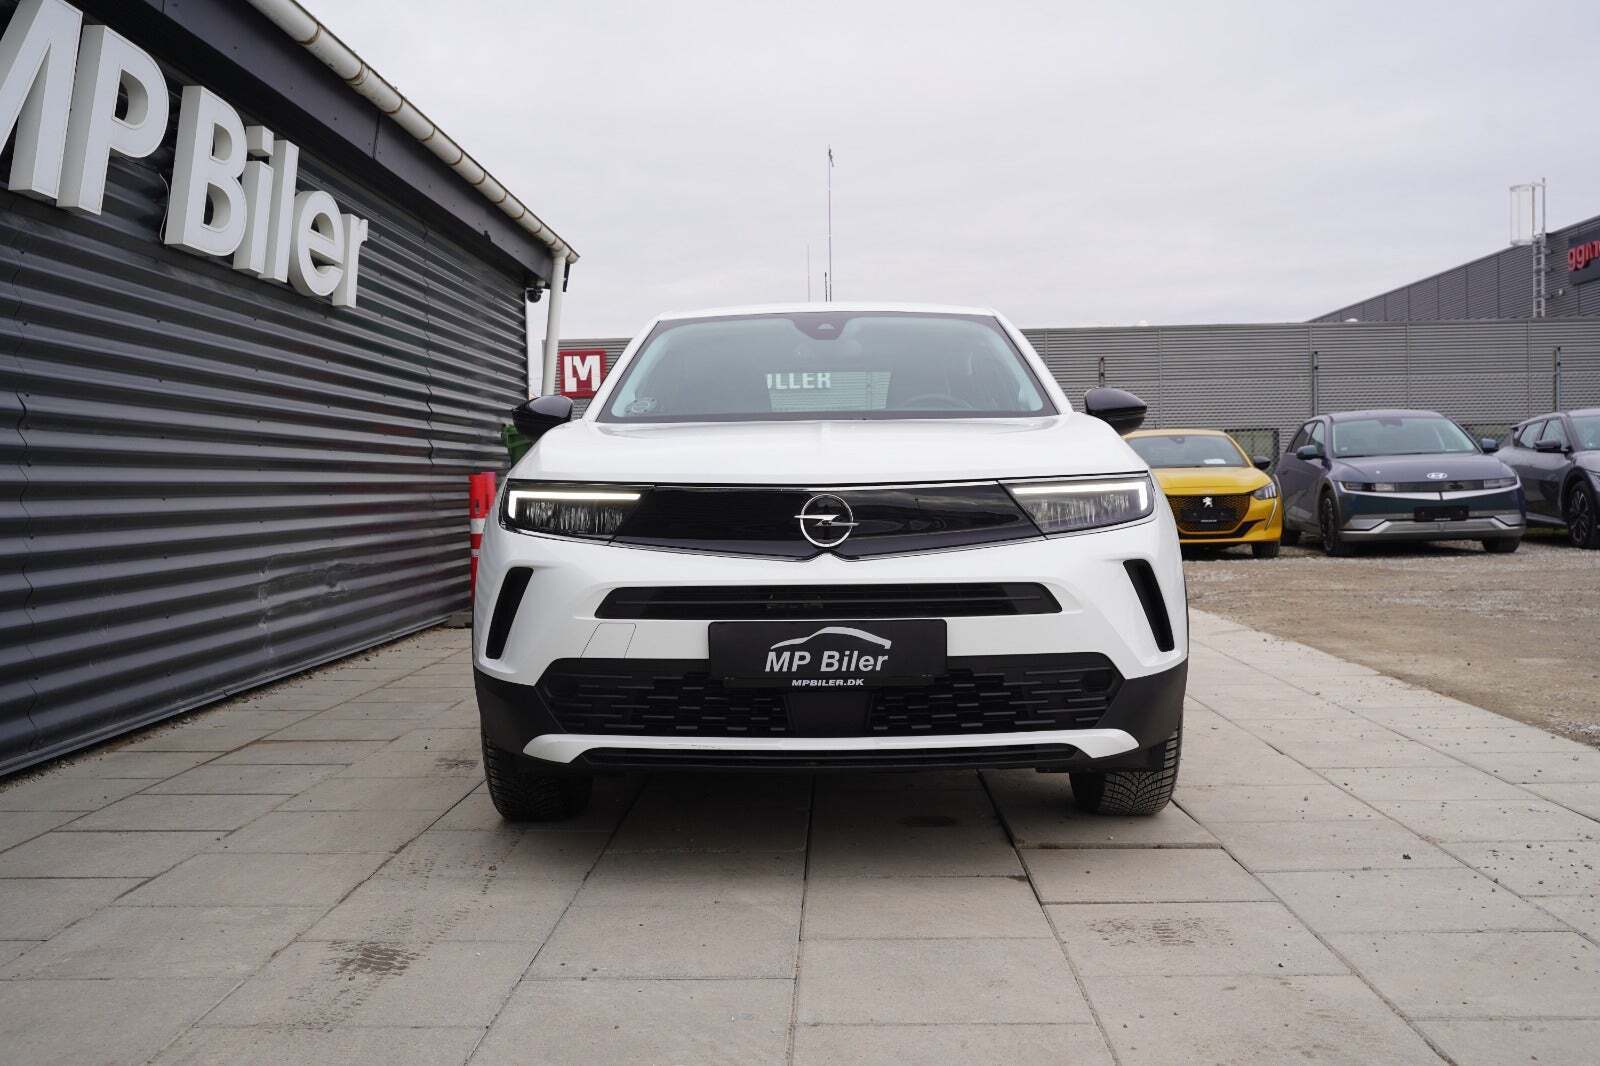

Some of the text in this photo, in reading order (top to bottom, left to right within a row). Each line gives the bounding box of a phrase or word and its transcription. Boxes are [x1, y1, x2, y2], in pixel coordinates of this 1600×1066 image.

[164, 86, 368, 309] Biler
[765, 650, 888, 672] MP Biler
[791, 678, 864, 687] MPBILER.DK
